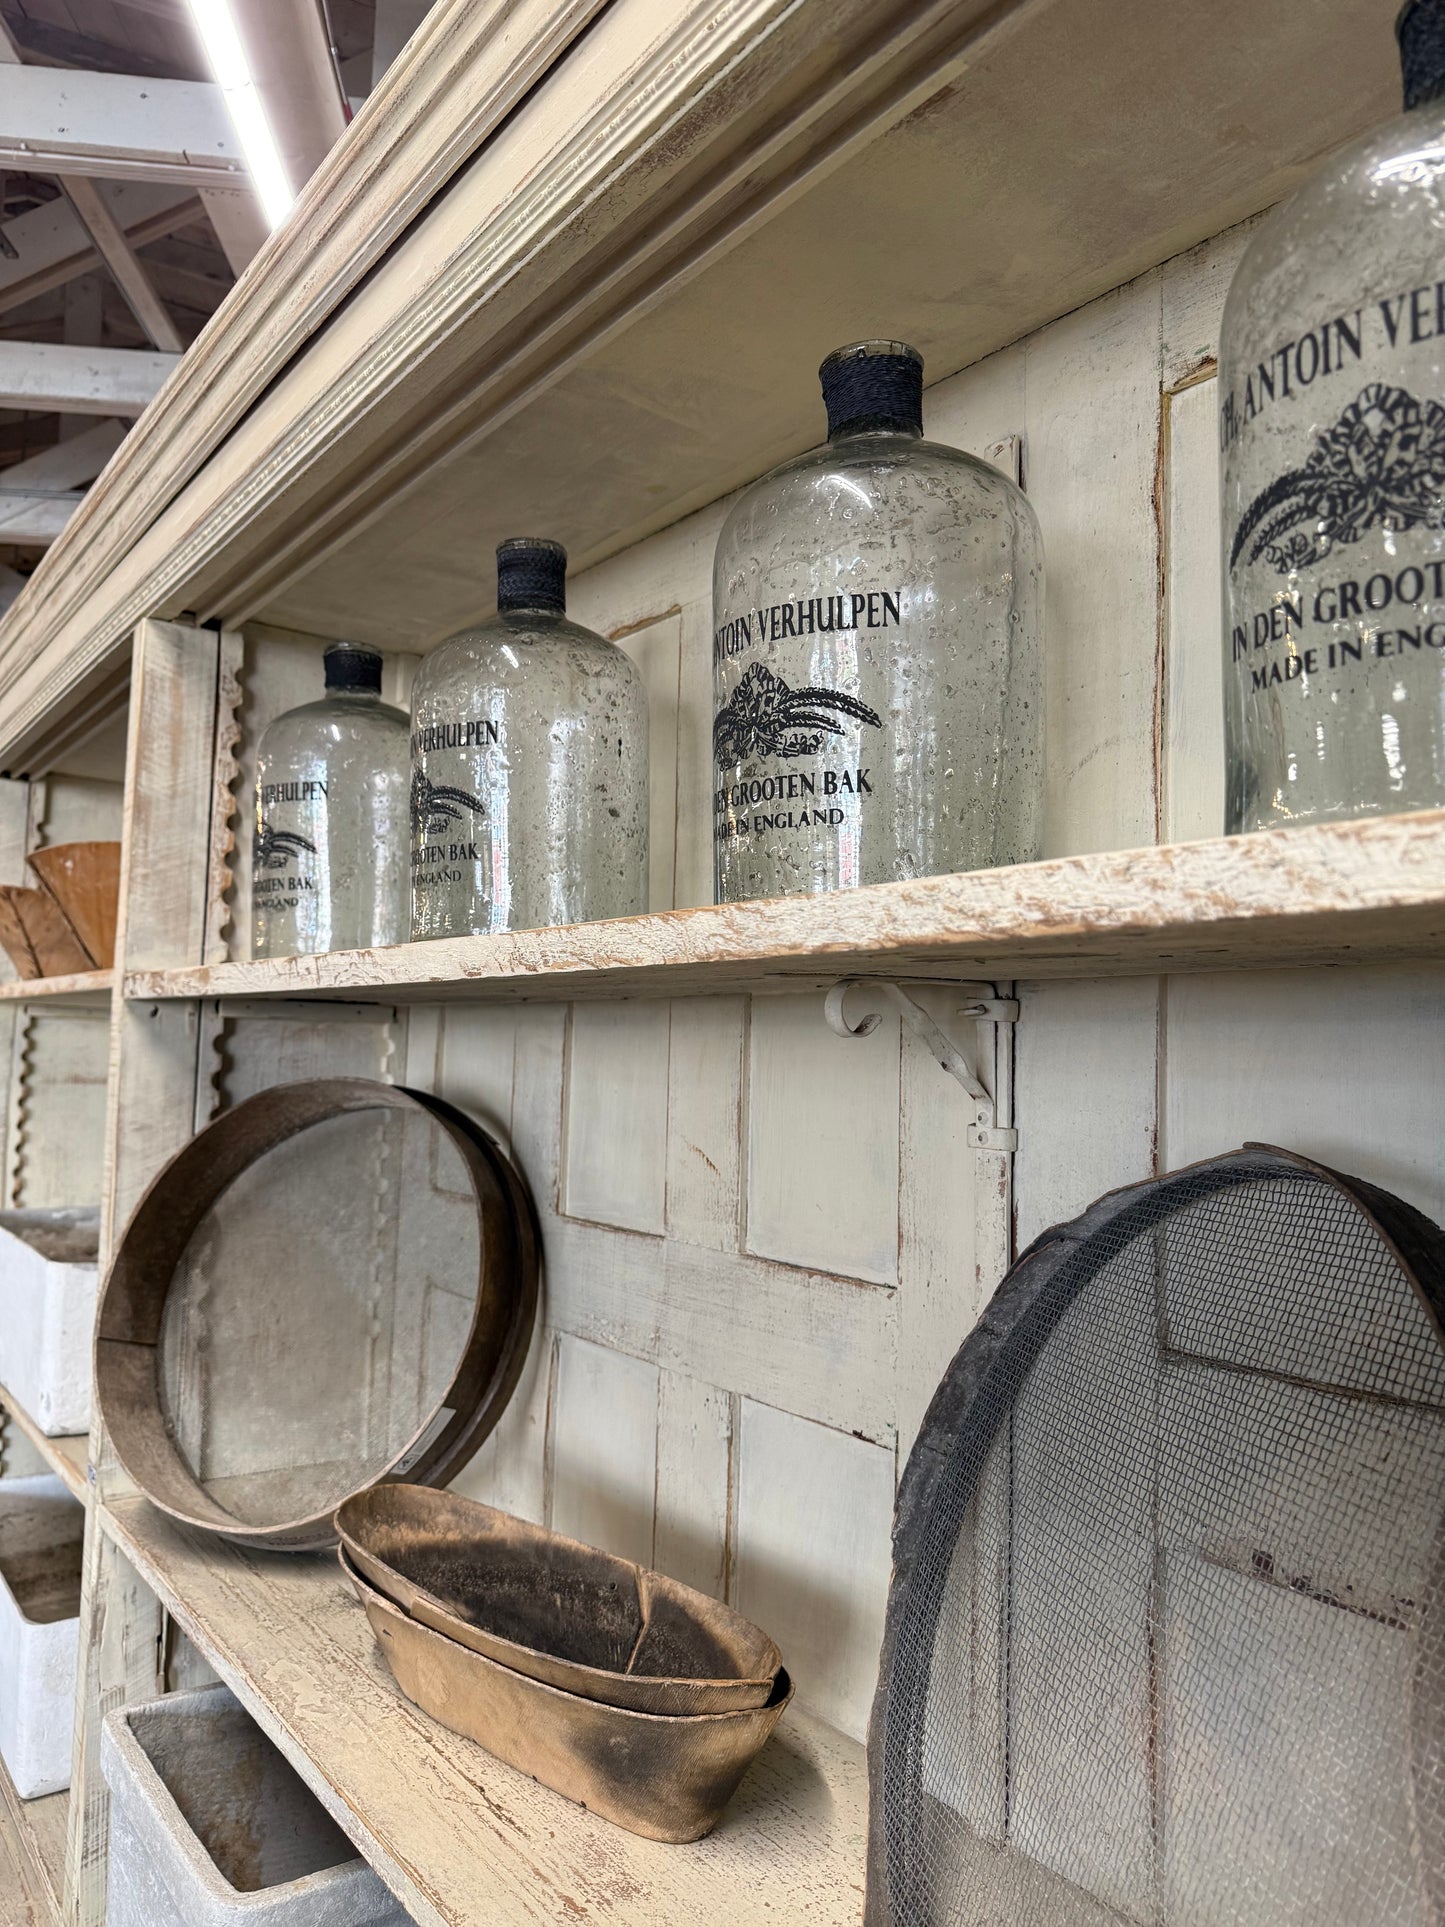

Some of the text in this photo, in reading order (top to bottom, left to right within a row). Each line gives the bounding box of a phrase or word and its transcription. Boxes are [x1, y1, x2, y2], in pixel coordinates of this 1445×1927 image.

[1243, 309, 1363, 425] ANTOIN
[713, 591, 902, 664] NTOIN VERHULPEN
[1233, 561, 1445, 663] IN DEN GROOT
[1251, 648, 1319, 693] MADE
[1328, 638, 1362, 668] IN
[731, 772, 816, 807] GROOTEN
[823, 769, 872, 795] BAK
[754, 808, 845, 832] ENGLAND
[450, 842, 479, 861] BAK
[288, 876, 313, 891] BAK
